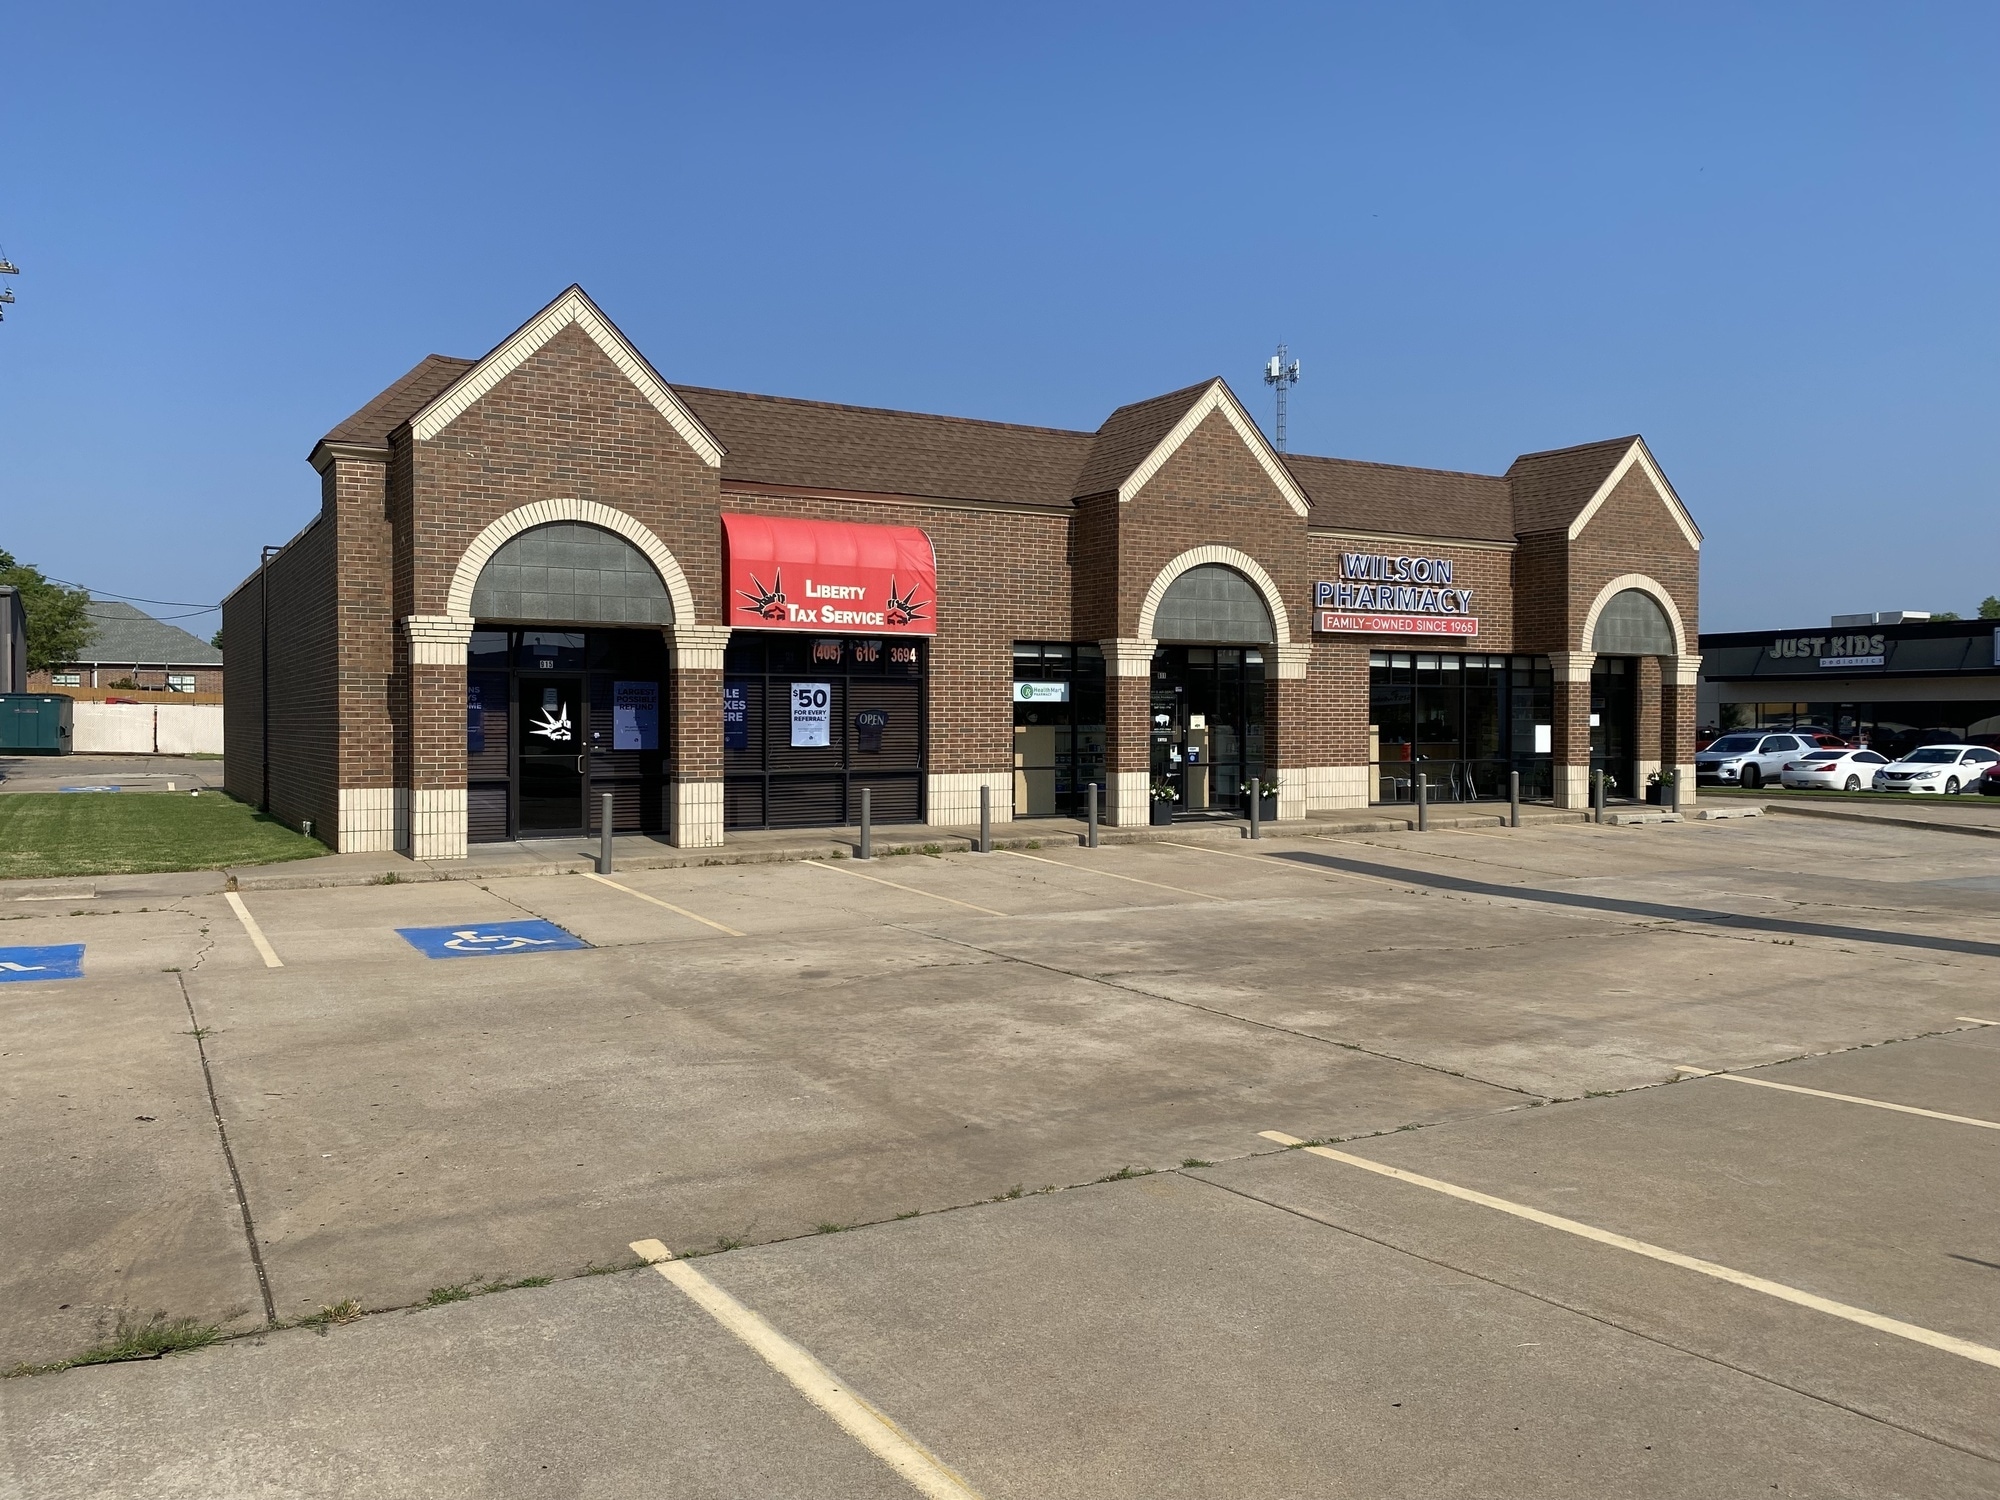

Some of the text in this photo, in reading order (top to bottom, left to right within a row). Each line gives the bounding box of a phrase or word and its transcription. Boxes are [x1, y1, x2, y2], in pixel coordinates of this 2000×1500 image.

[1343, 553, 1453, 584] WILSON
[805, 579, 866, 600] LIBERTY
[1315, 581, 1474, 614] PHARMACY
[787, 604, 885, 626] TAX SERVICE
[1326, 616, 1474, 633] FAMILY-OWNED SINCE 1965
[1769, 634, 1886, 659] JUST KIDS
[813, 644, 917, 664] (405) 610- 3694
[540, 660, 553, 669] 915
[1821, 658, 1883, 666] pediatrics
[617, 688, 655, 696] LARGEST
[723, 688, 740, 698] ILE
[792, 689, 828, 708] $50
[616, 695, 657, 703] POSSIBLE
[723, 700, 746, 710] XES
[619, 703, 654, 711] REFUND
[723, 712, 743, 722] ERE
[859, 713, 885, 726] OPEN
